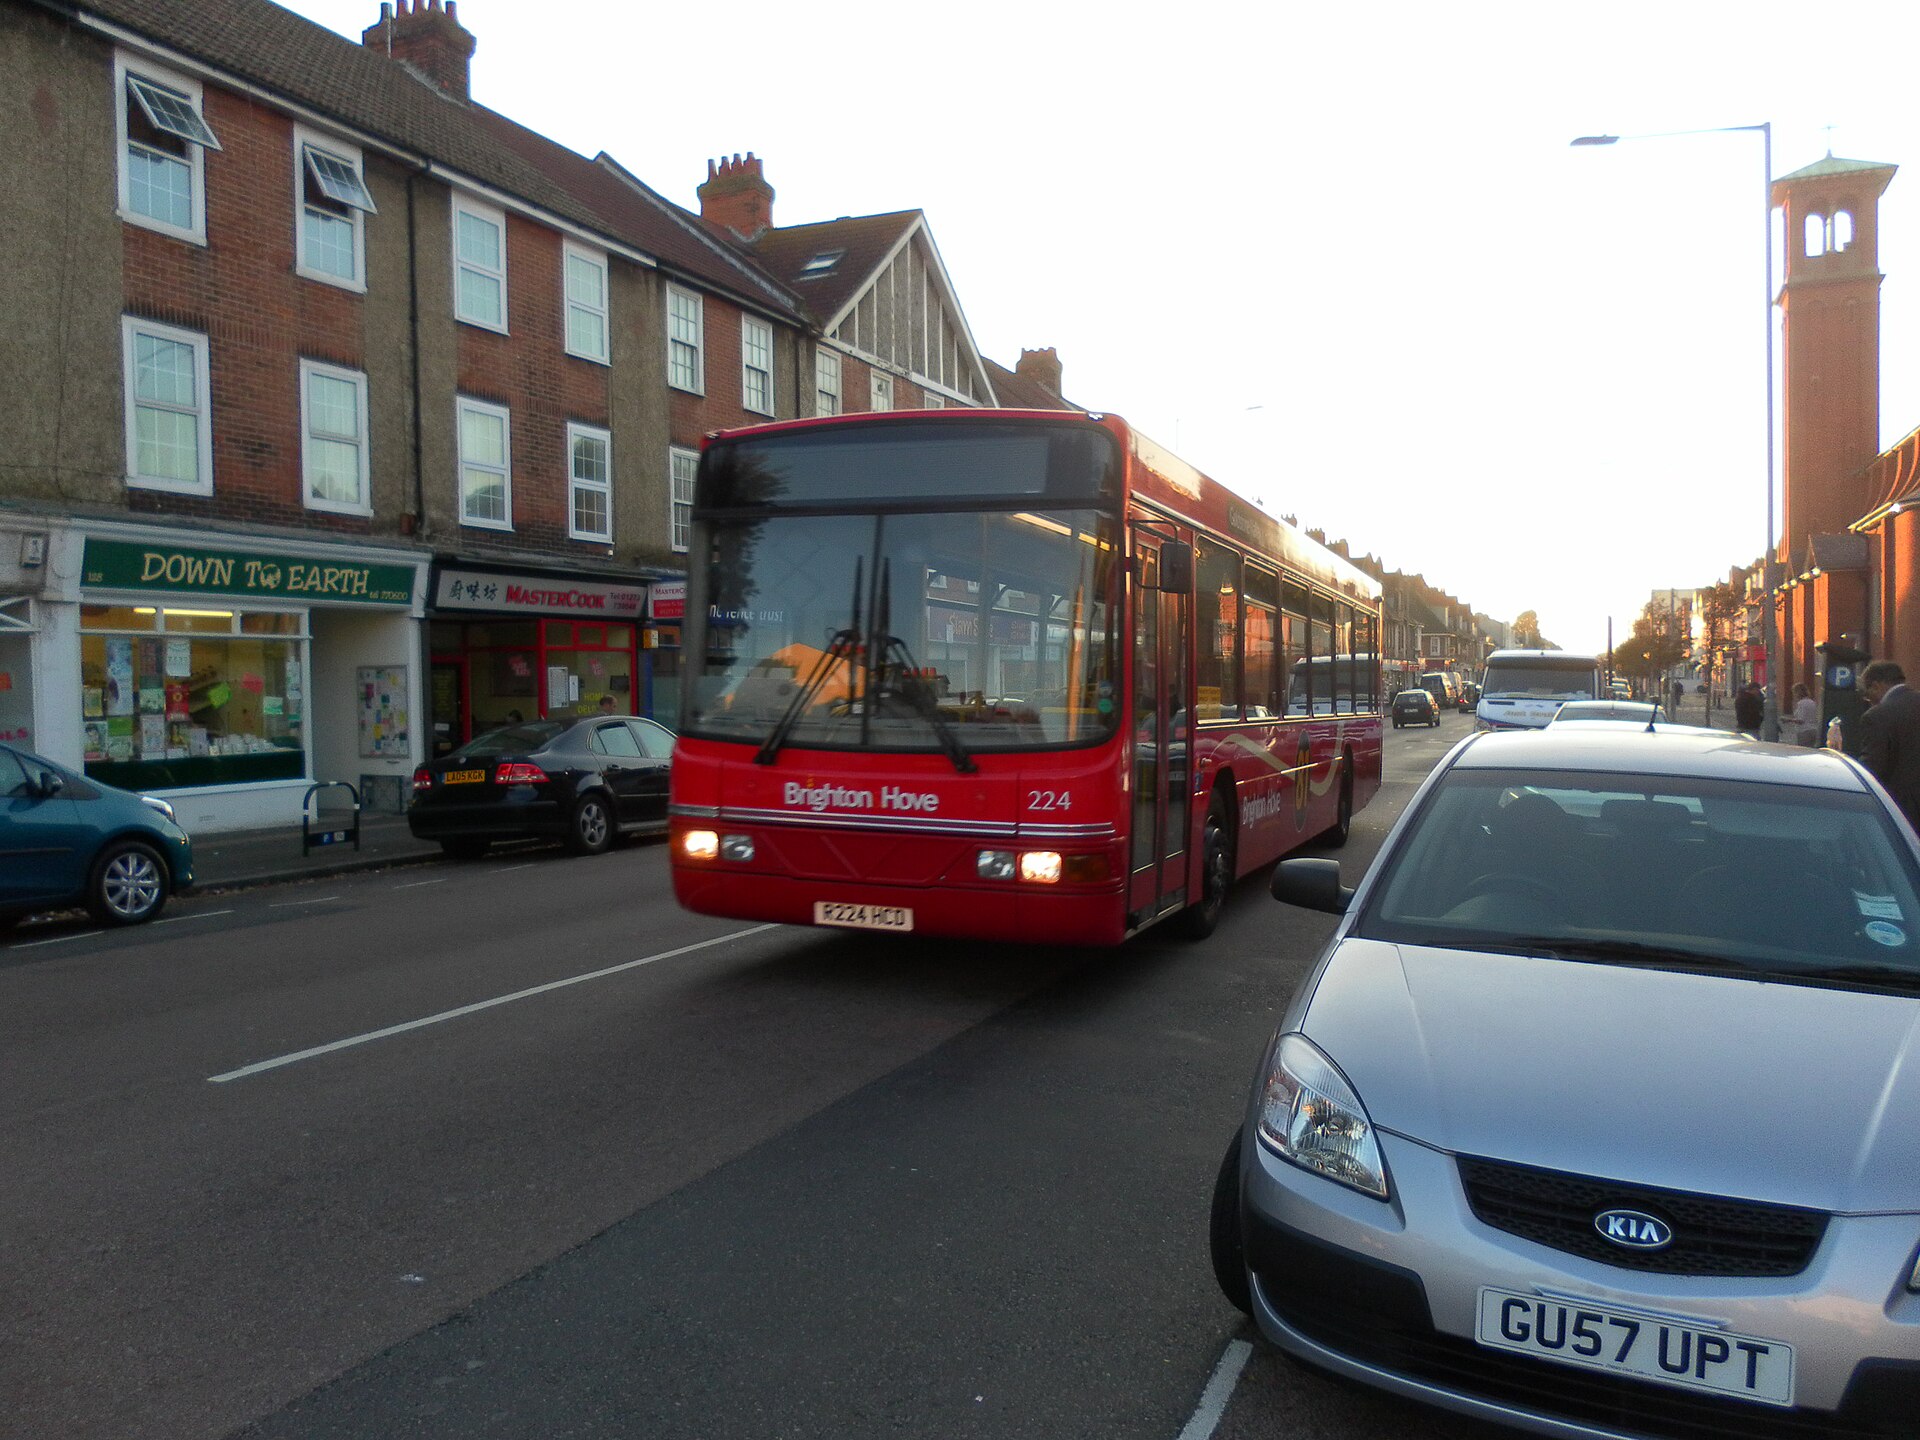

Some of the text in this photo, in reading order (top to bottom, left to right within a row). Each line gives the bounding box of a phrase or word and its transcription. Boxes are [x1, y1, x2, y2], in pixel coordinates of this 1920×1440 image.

[141, 552, 235, 586] DOWN
[287, 565, 370, 595] EARTH
[1835, 666, 1851, 686] P
[784, 781, 940, 812] Brighton Hove
[1027, 790, 1072, 811] 224
[823, 904, 905, 926] R224 HCD
[1607, 1215, 1660, 1243] KIA
[1500, 1297, 1770, 1390] GU57 UPT
